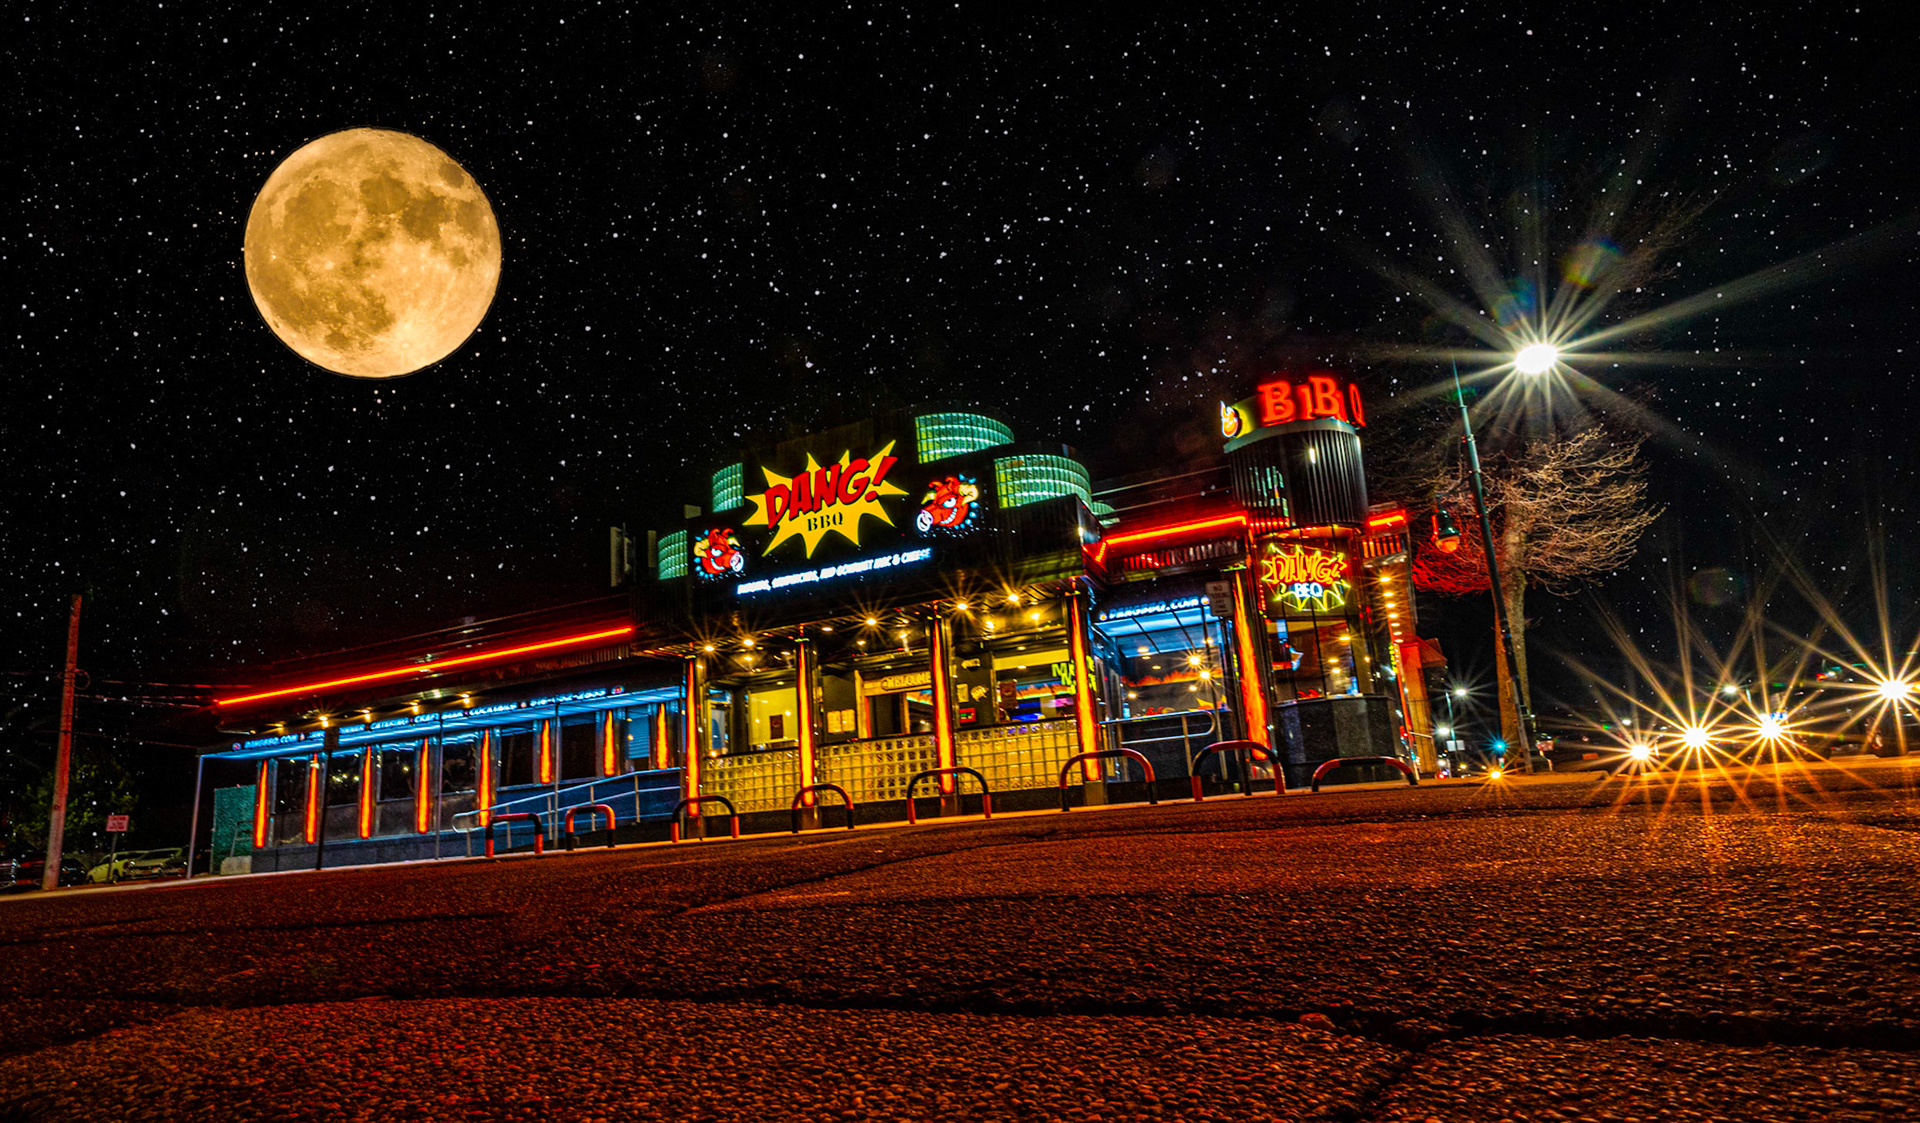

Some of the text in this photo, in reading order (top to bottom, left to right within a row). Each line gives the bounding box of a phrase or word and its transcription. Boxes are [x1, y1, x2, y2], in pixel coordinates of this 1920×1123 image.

[1258, 376, 1366, 427] BBQ
[764, 455, 898, 530] DANG!
[807, 512, 844, 531] BBQ
